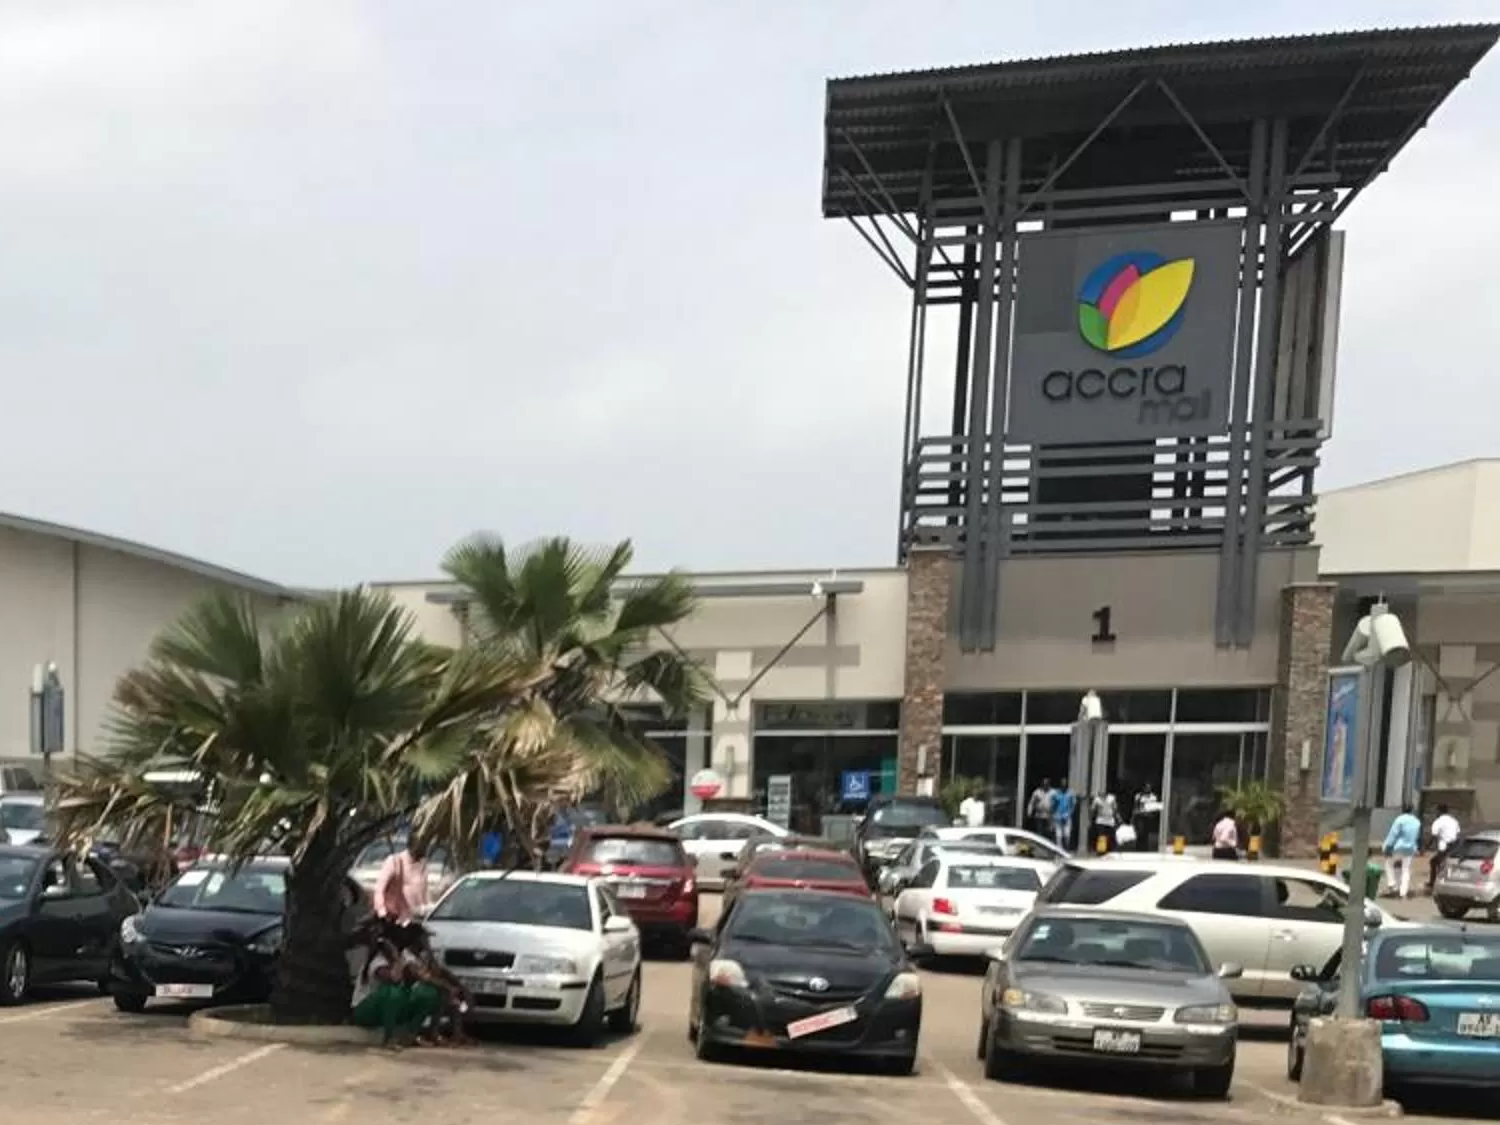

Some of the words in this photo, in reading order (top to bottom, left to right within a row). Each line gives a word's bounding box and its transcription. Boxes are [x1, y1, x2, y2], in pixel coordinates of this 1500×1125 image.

[1042, 364, 1187, 402] accra
[1138, 388, 1212, 425] mall
[1091, 605, 1117, 642] 1
